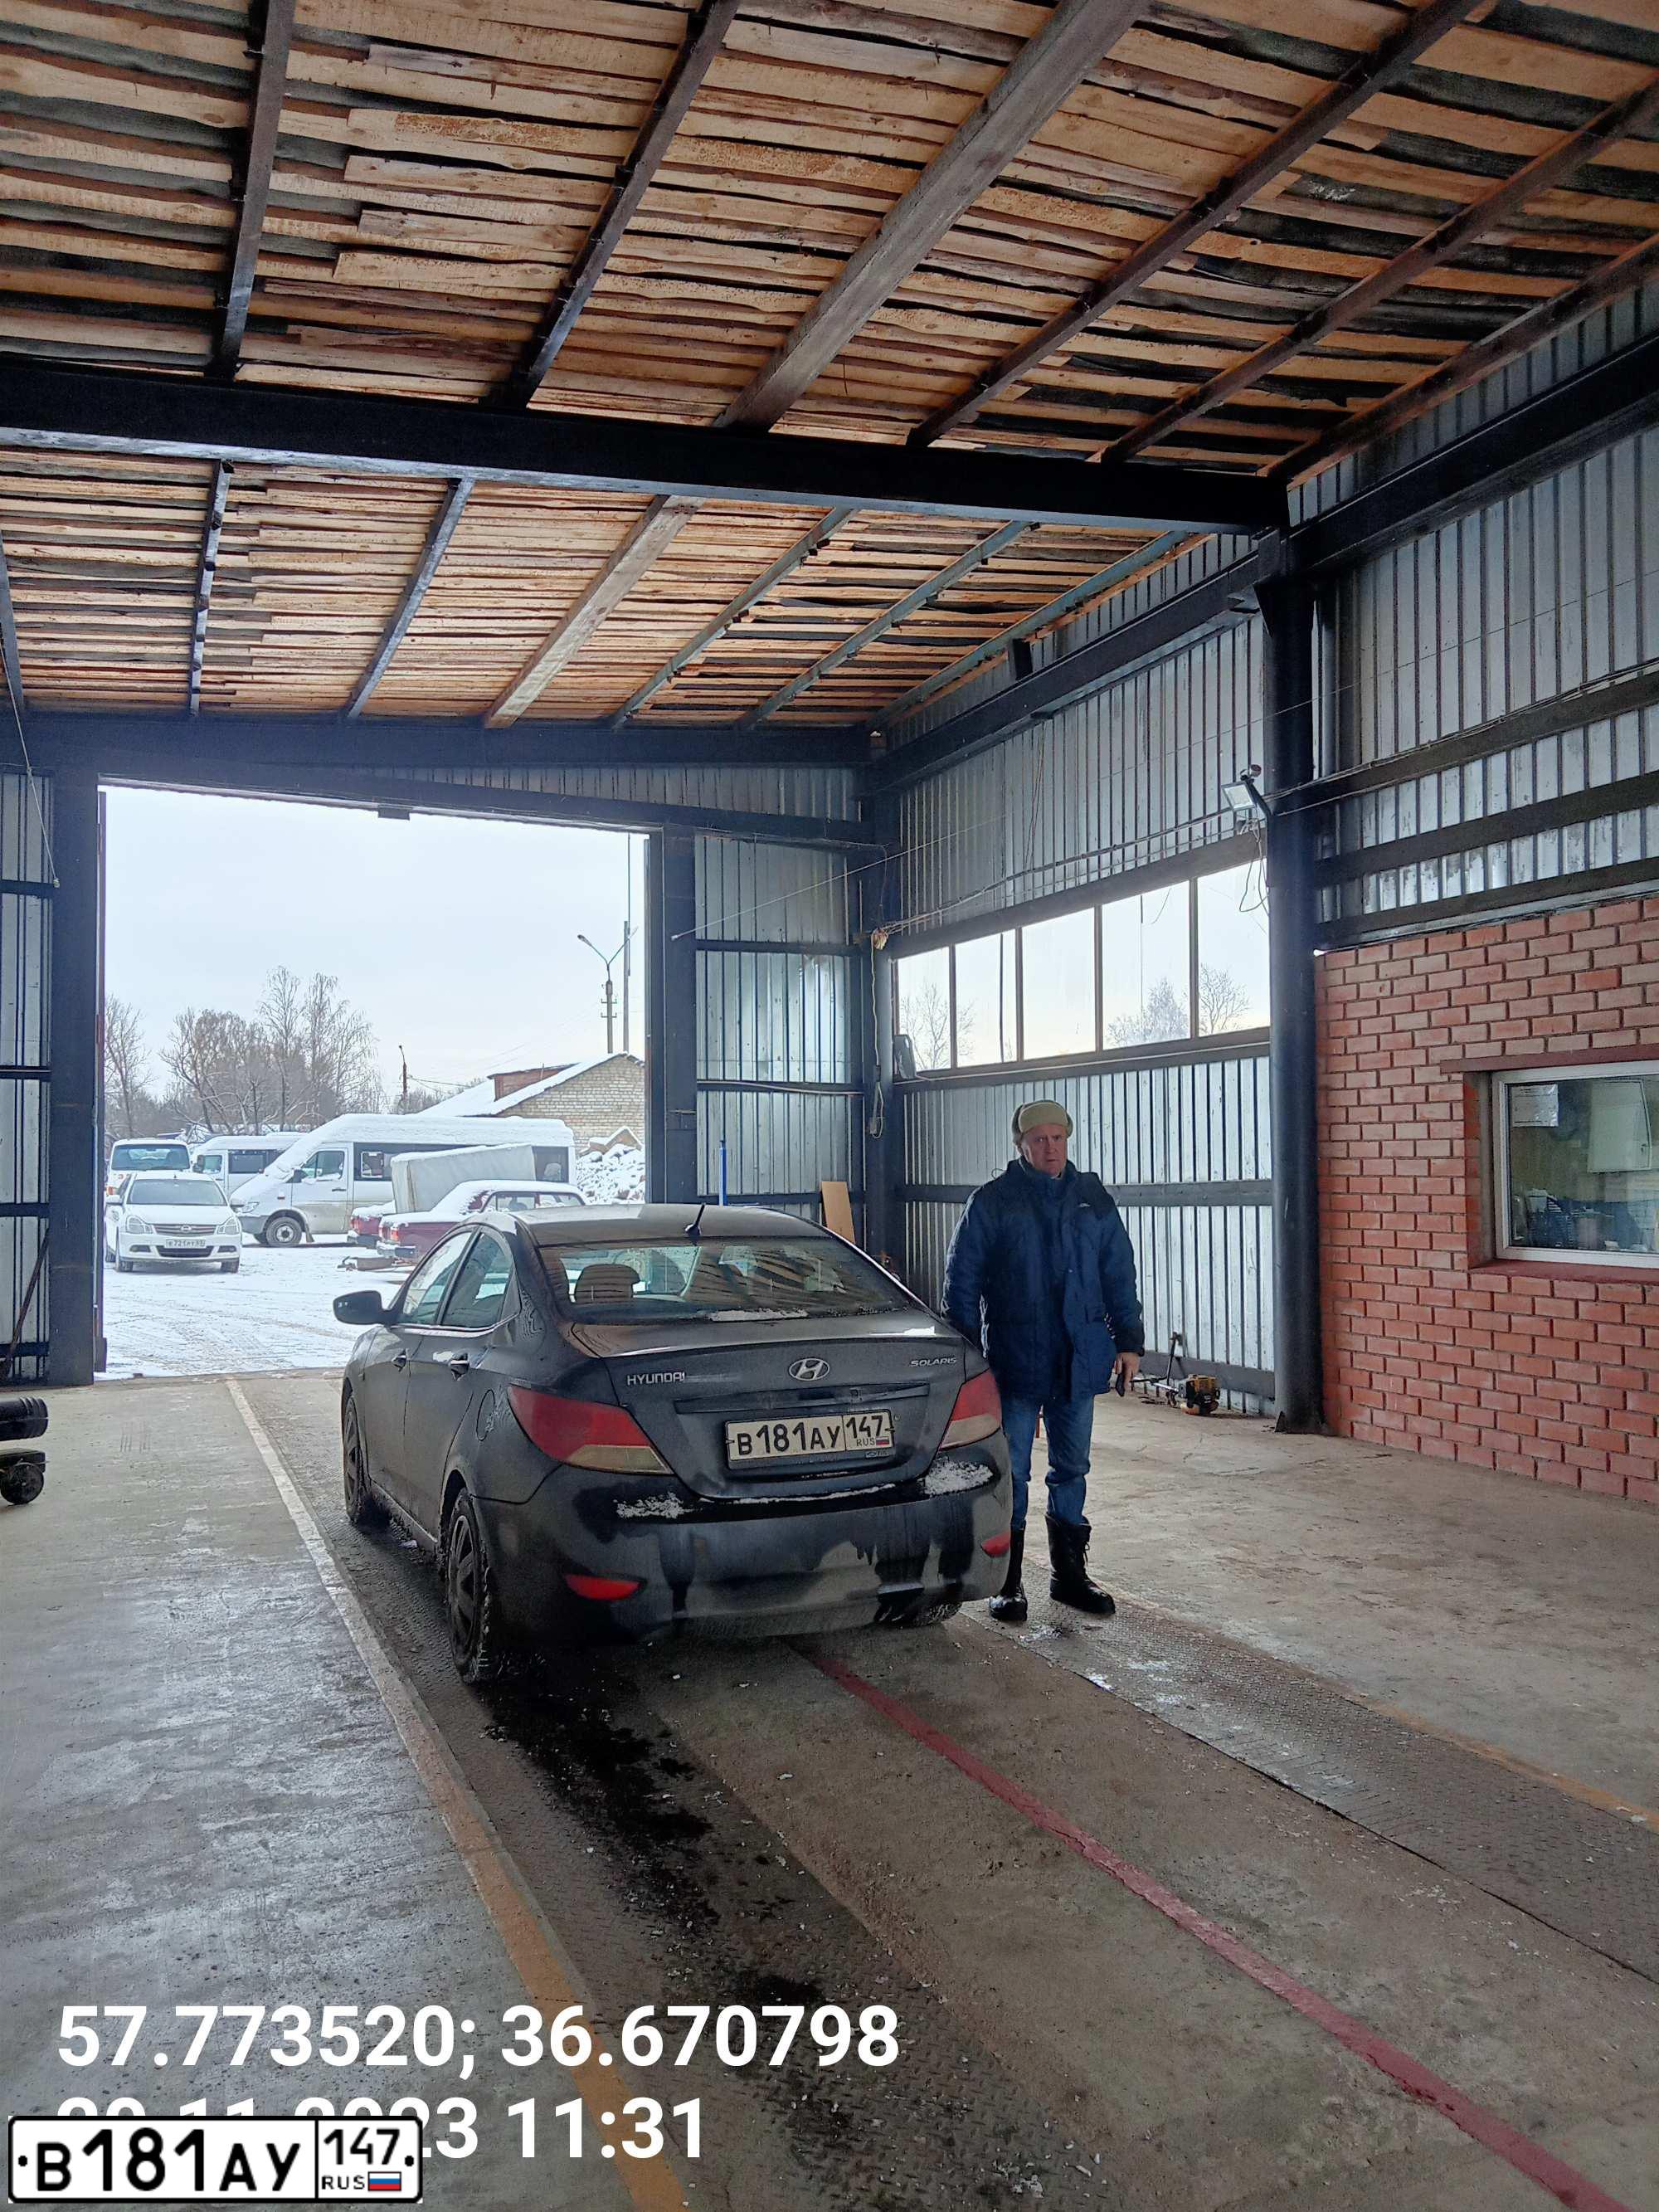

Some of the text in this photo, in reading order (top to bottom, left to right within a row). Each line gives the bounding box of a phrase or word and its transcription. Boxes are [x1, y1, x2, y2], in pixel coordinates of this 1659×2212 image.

[909, 1357, 956, 1367] SOLARIS
[626, 1372, 685, 1386] HYUNDAI
[737, 1415, 883, 1455] В181АУ 147
[856, 1437, 876, 1447] RUS
